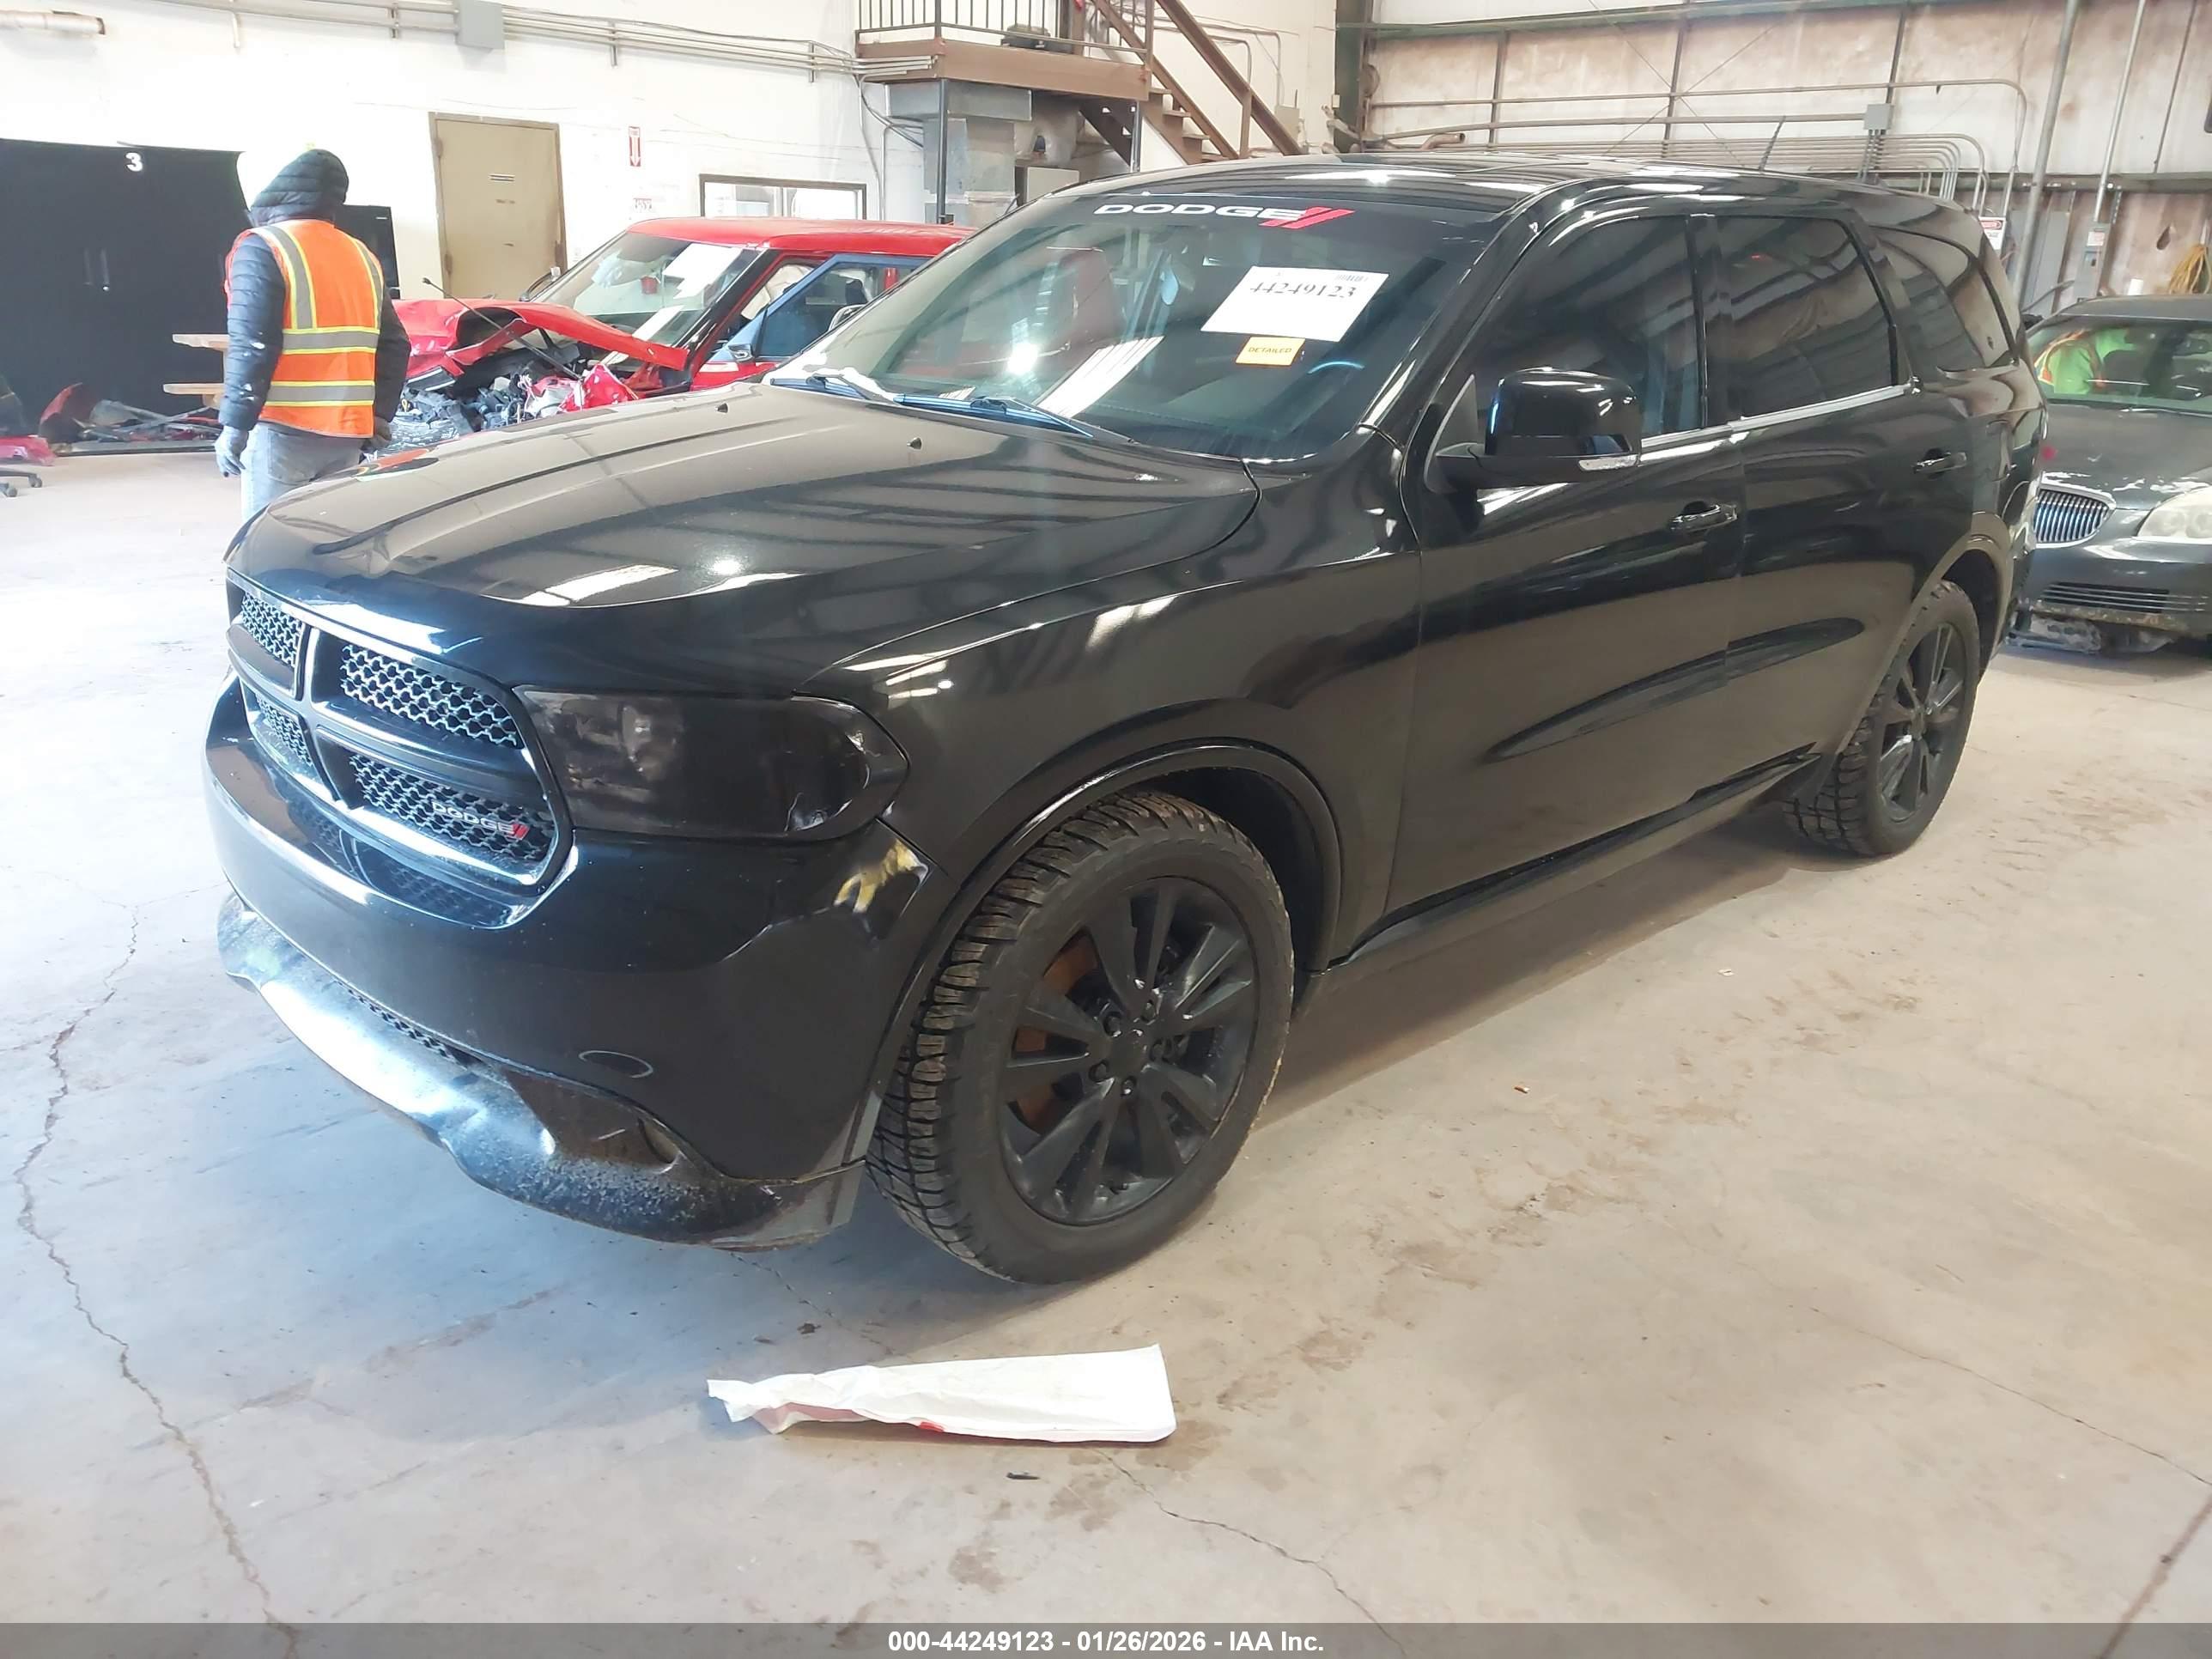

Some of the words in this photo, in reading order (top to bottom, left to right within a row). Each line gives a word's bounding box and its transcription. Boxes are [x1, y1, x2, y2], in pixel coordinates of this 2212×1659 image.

[125, 152, 143, 172] 3
[1093, 204, 1306, 222] DODGE
[1249, 282, 1357, 298] 44249123
[431, 800, 515, 836] DODGE
